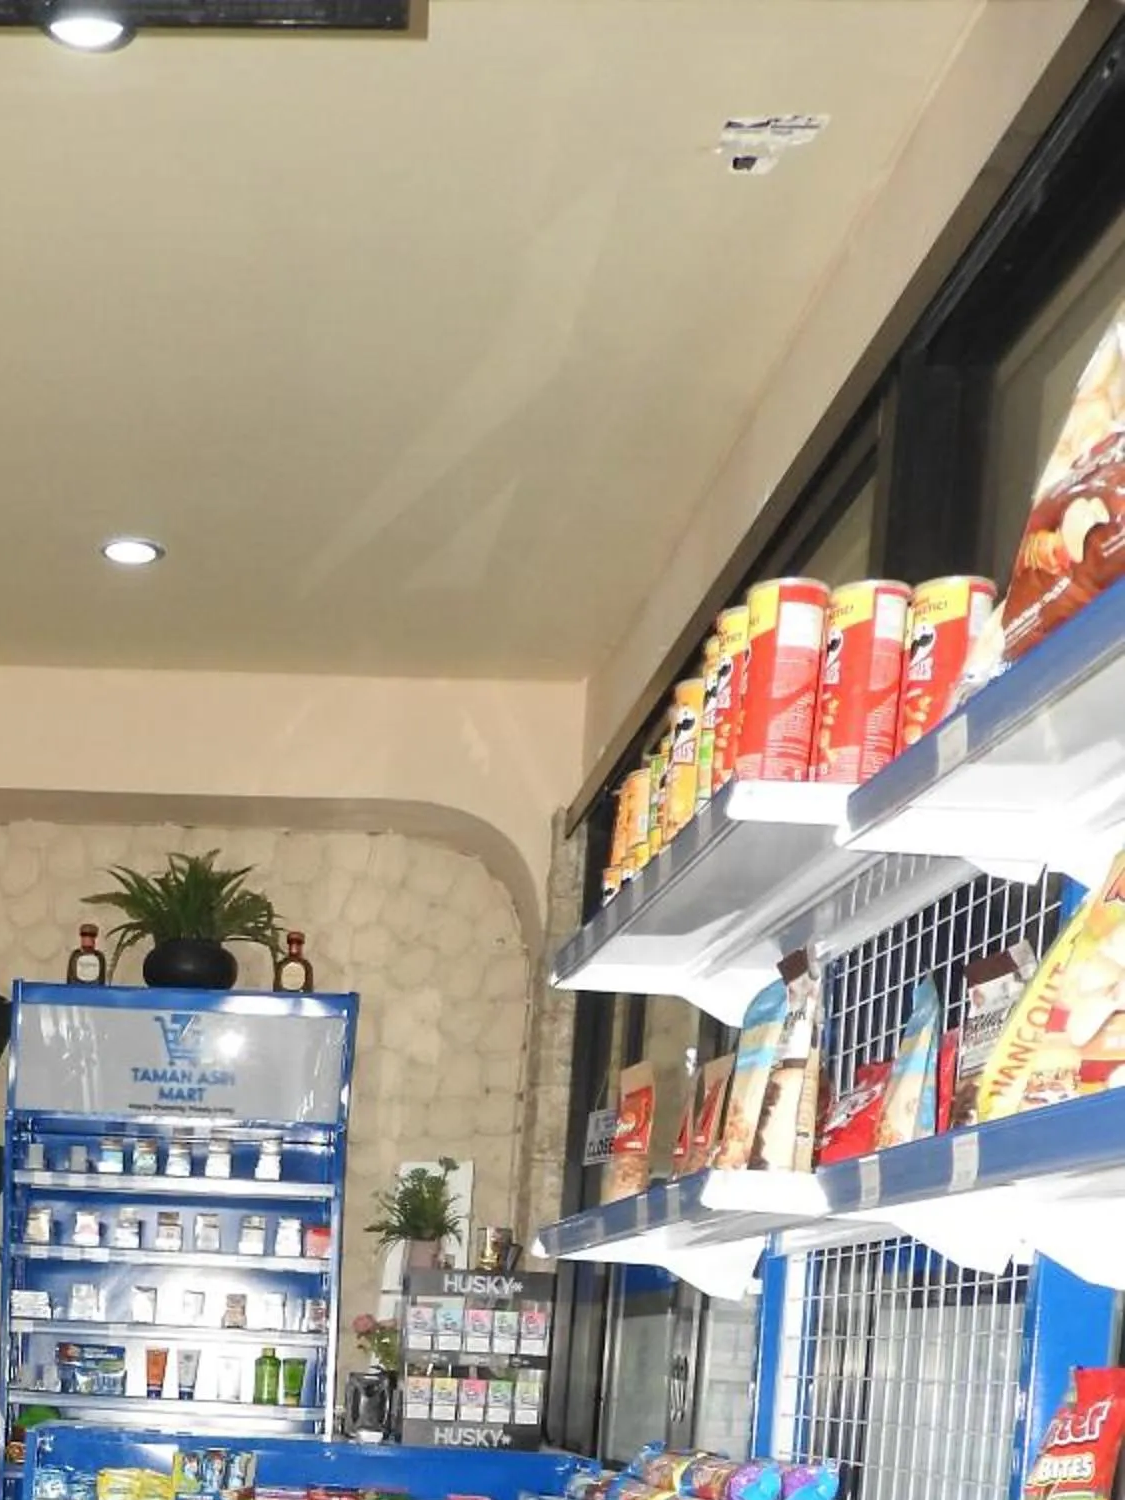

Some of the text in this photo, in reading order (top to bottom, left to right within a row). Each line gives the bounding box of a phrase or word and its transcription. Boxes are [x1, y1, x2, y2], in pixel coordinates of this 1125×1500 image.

[131, 1067, 235, 1086] TAMAN ASRI
[158, 1087, 207, 1102] MART
[443, 1274, 512, 1294] HUSKY
[434, 1428, 504, 1447] HUSKY
